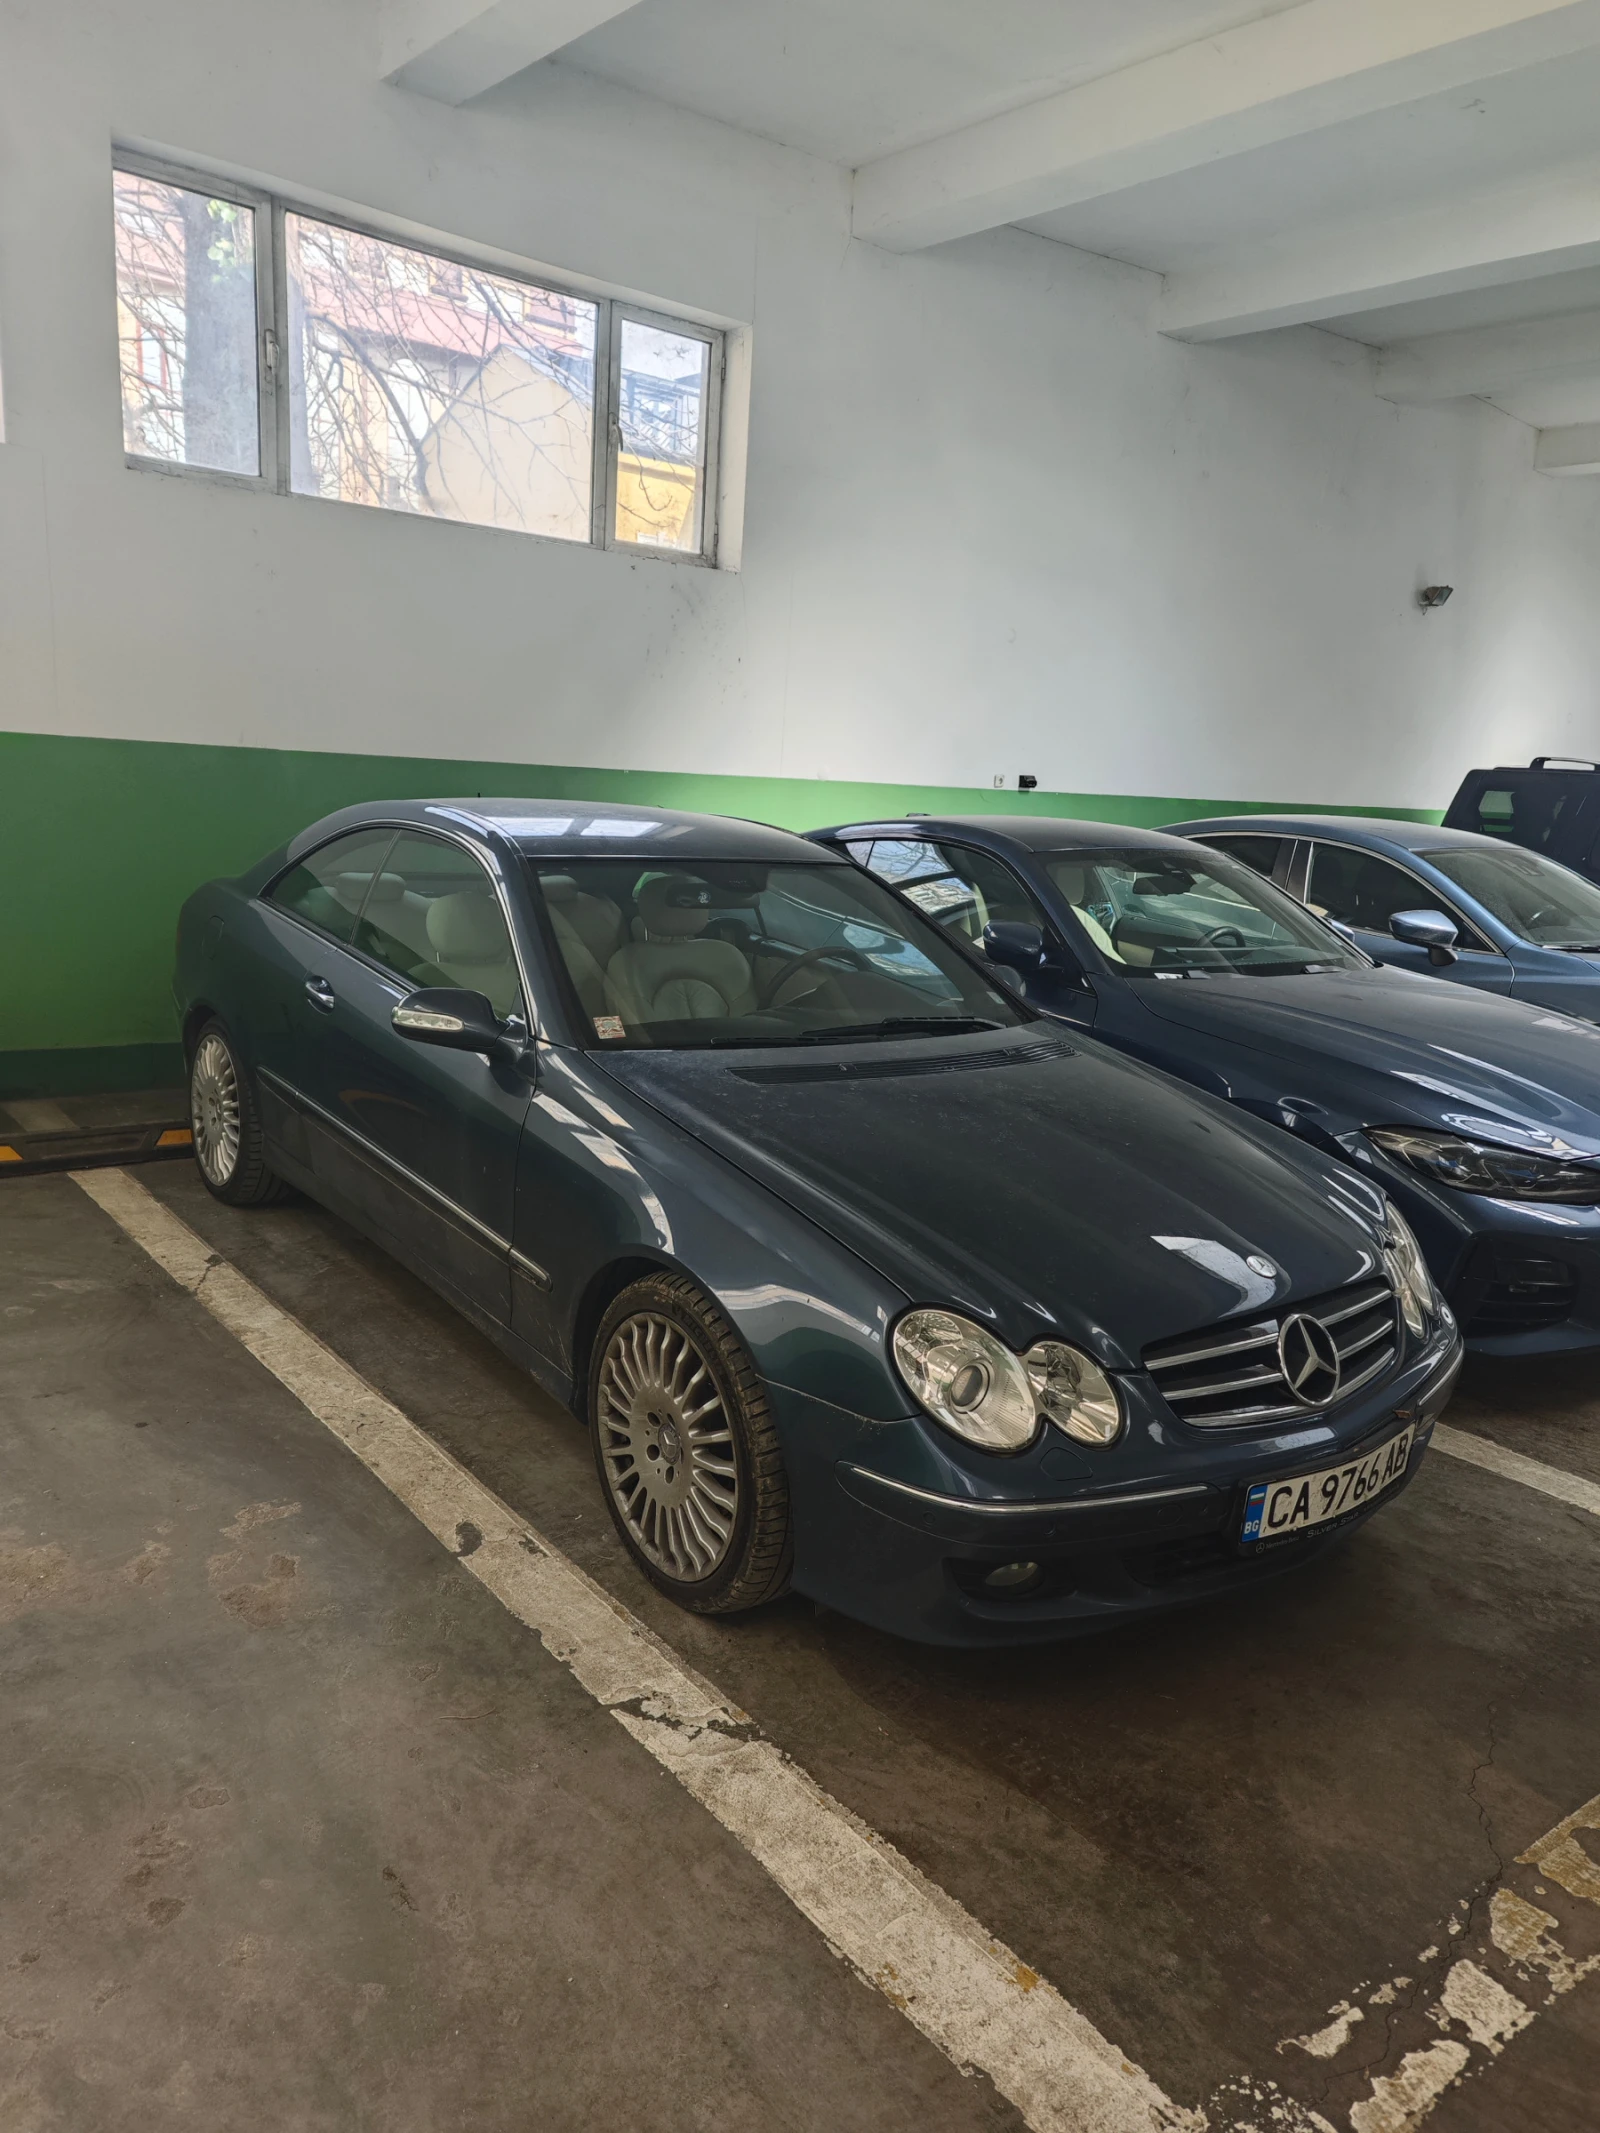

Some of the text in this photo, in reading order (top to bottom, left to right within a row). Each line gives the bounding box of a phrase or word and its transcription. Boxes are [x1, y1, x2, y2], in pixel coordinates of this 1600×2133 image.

[1267, 1481, 1310, 1528] CA
[1321, 1453, 1381, 1515] 9766
[1382, 1433, 1409, 1483] AB
[1243, 1520, 1260, 1535] BG
